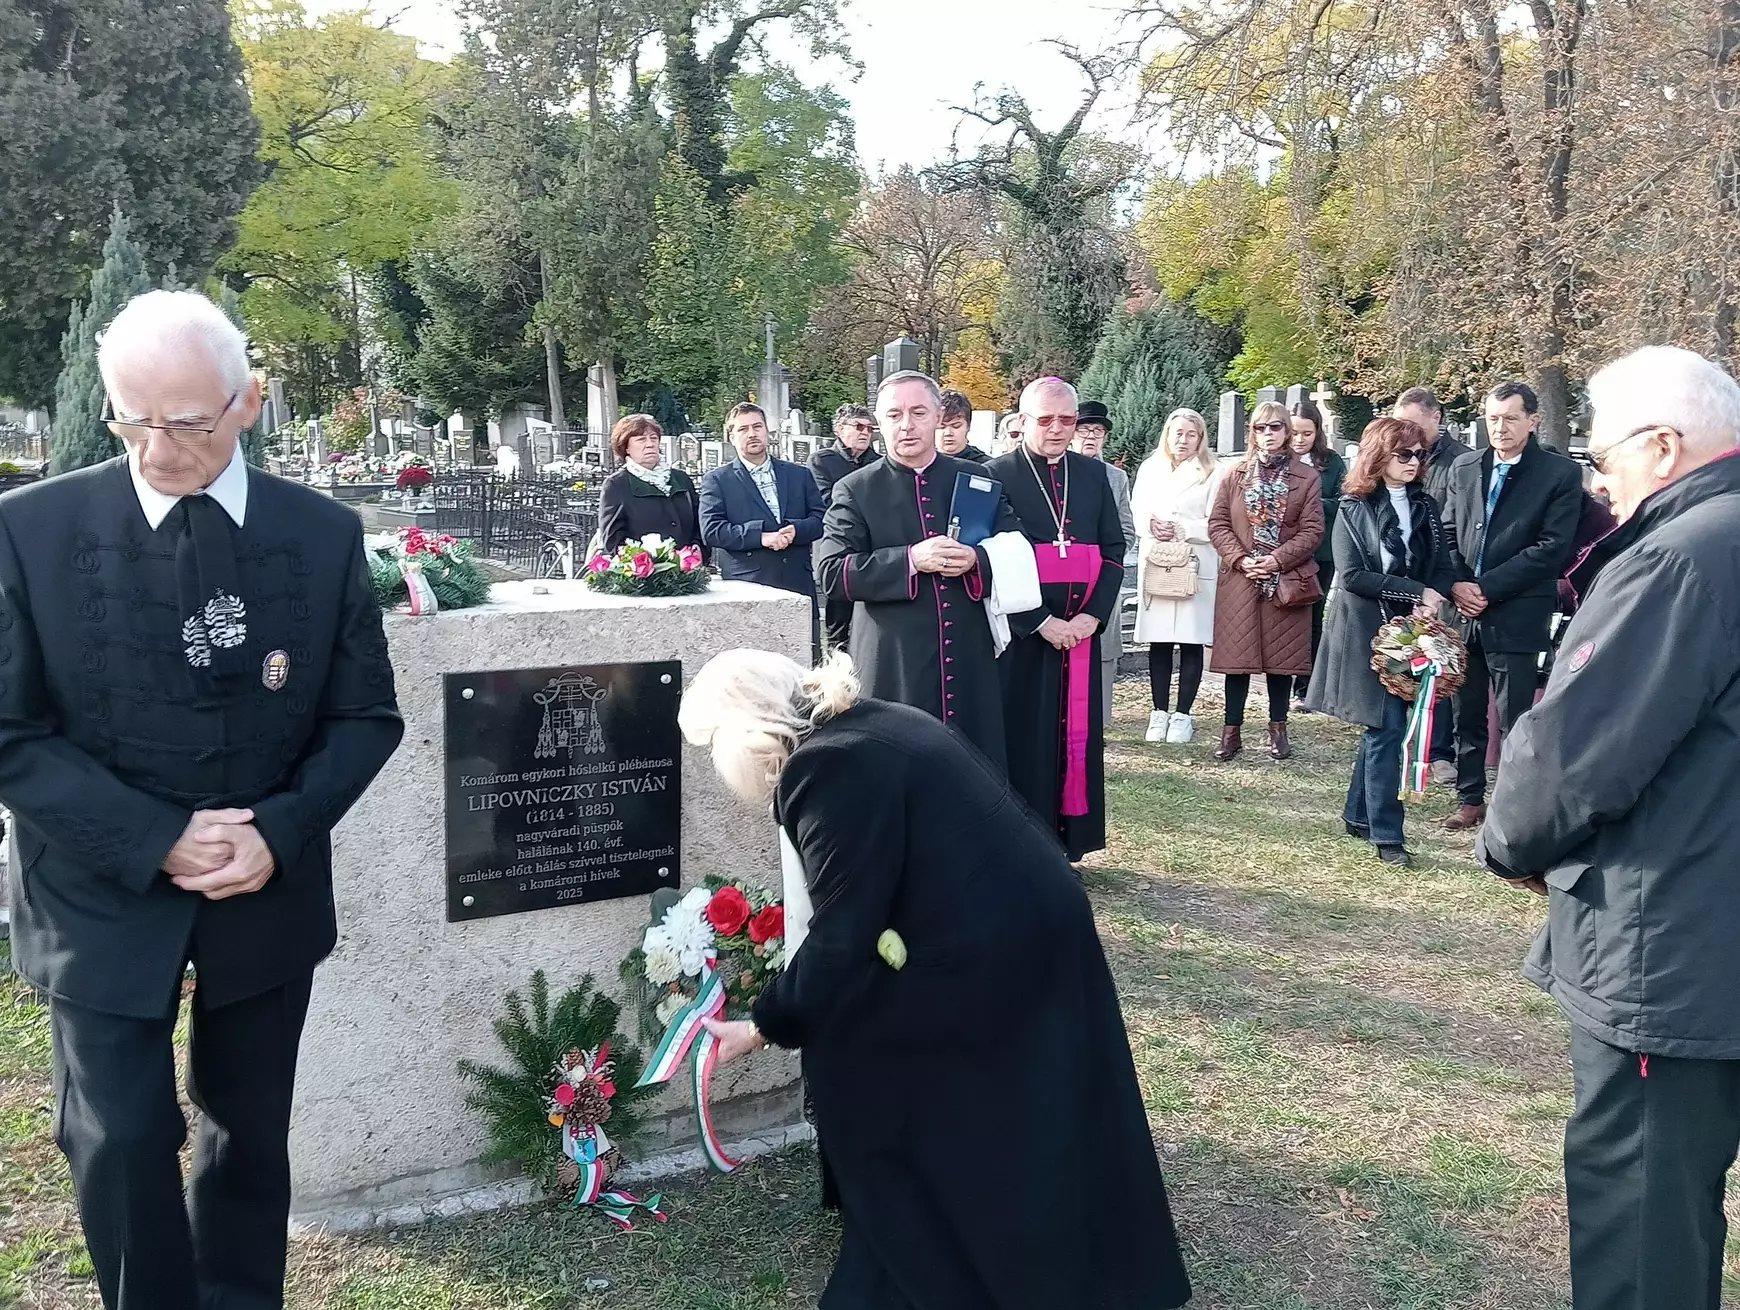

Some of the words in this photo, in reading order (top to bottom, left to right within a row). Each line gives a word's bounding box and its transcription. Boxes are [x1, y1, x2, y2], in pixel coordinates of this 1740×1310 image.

[460, 772, 519, 787] Komárom
[522, 766, 566, 782] egykori
[568, 760, 616, 776] hőslelkű
[618, 756, 674, 773] plébánosa
[468, 783, 598, 812] LIPOVNICZKY
[601, 772, 668, 797] ISTVÁN
[526, 807, 566, 824] (1814
[578, 802, 615, 818] 1885)
[516, 825, 581, 842] nagyváradi
[517, 843, 574, 860] halálának
[577, 839, 601, 852] 140.
[604, 836, 624, 849] évf.
[505, 864, 534, 877] előtt
[535, 859, 567, 873] hálás
[569, 854, 607, 869] szívvel
[609, 845, 675, 864] tisztelegnek
[519, 882, 527, 891] a
[530, 872, 588, 890] komáromi
[590, 867, 621, 881] hívek
[557, 887, 583, 900] 2025
